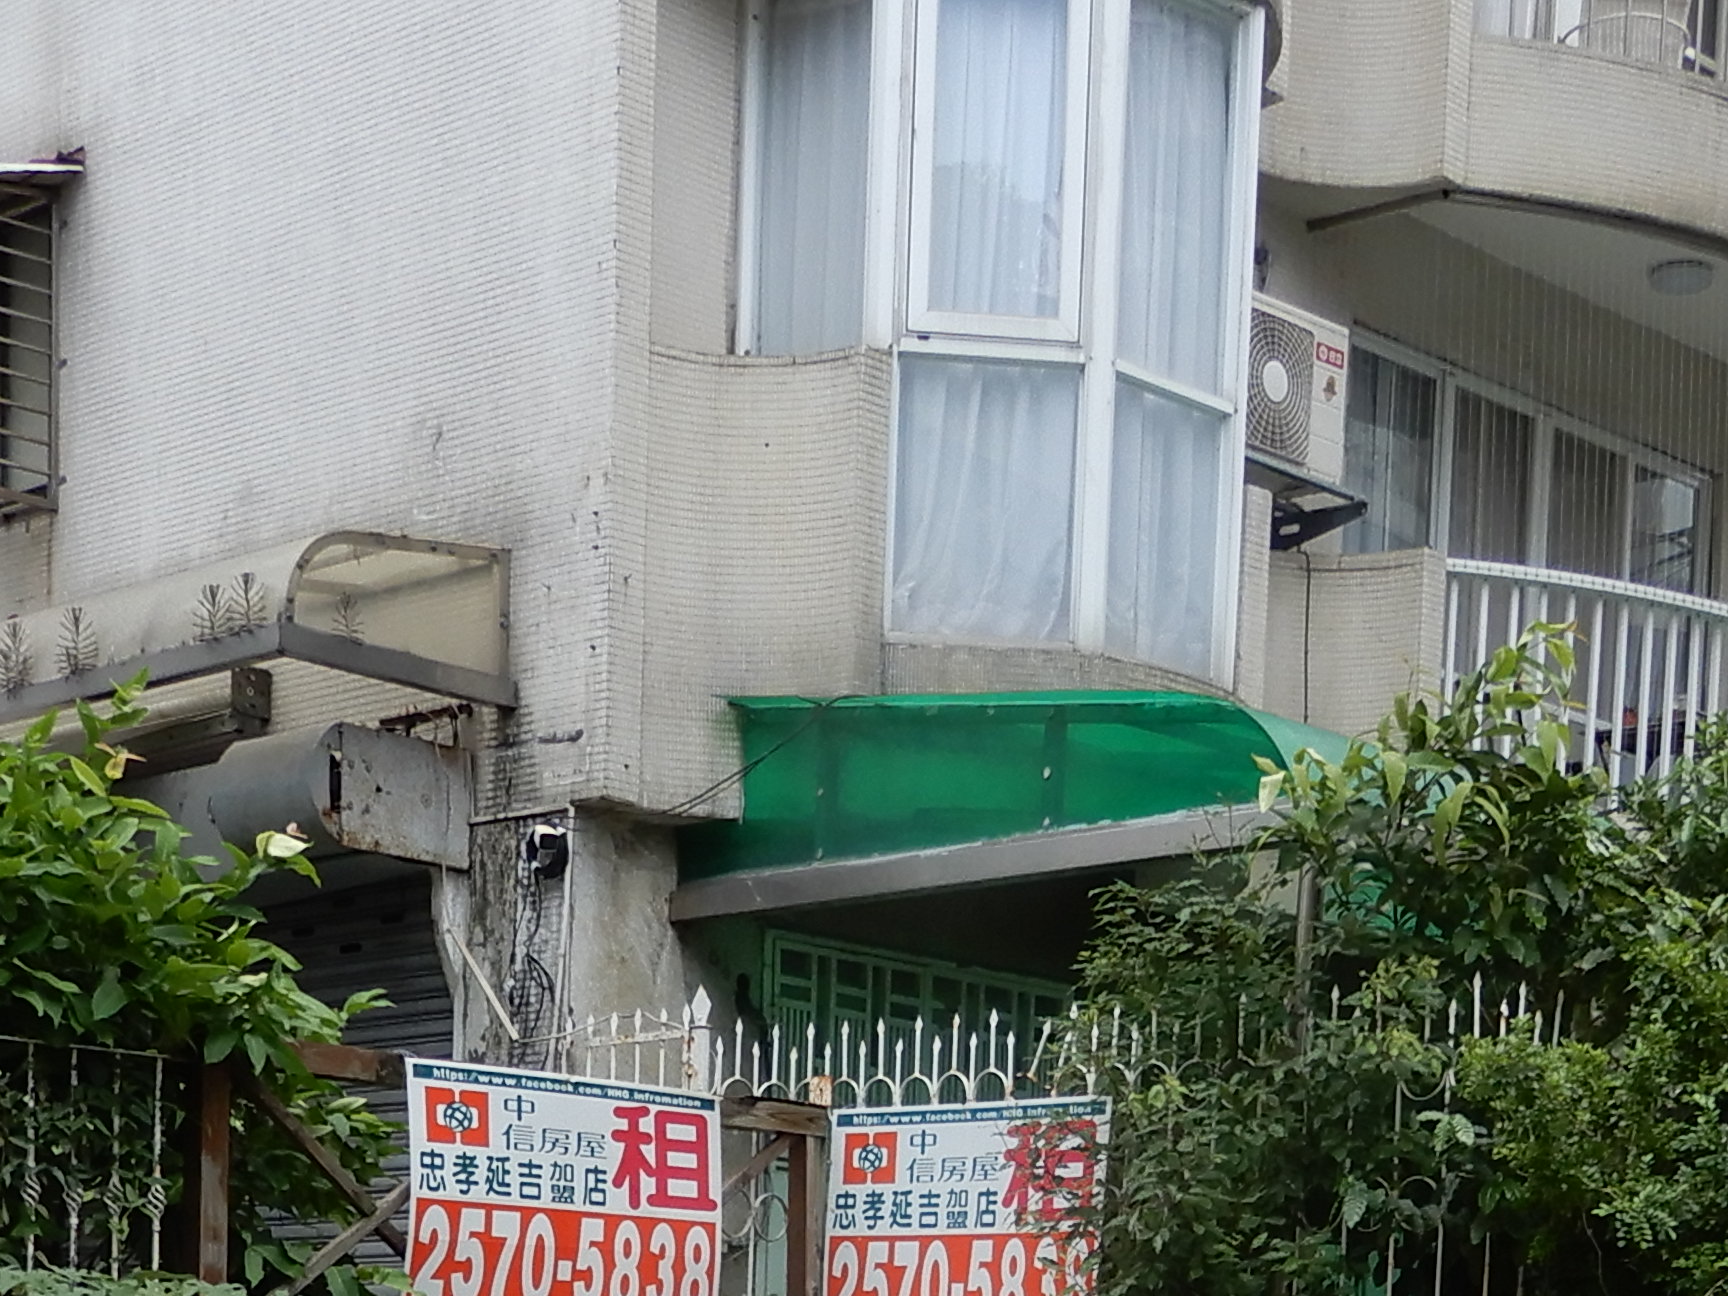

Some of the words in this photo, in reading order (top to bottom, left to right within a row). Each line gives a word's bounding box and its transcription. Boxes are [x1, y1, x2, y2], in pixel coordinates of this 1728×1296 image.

[503, 1094, 535, 1122] 中
[501, 1123, 608, 1160] 信房屋
[909, 1129, 937, 1155] 中
[611, 1105, 718, 1211] 租
[906, 1155, 1000, 1185] 信房屋
